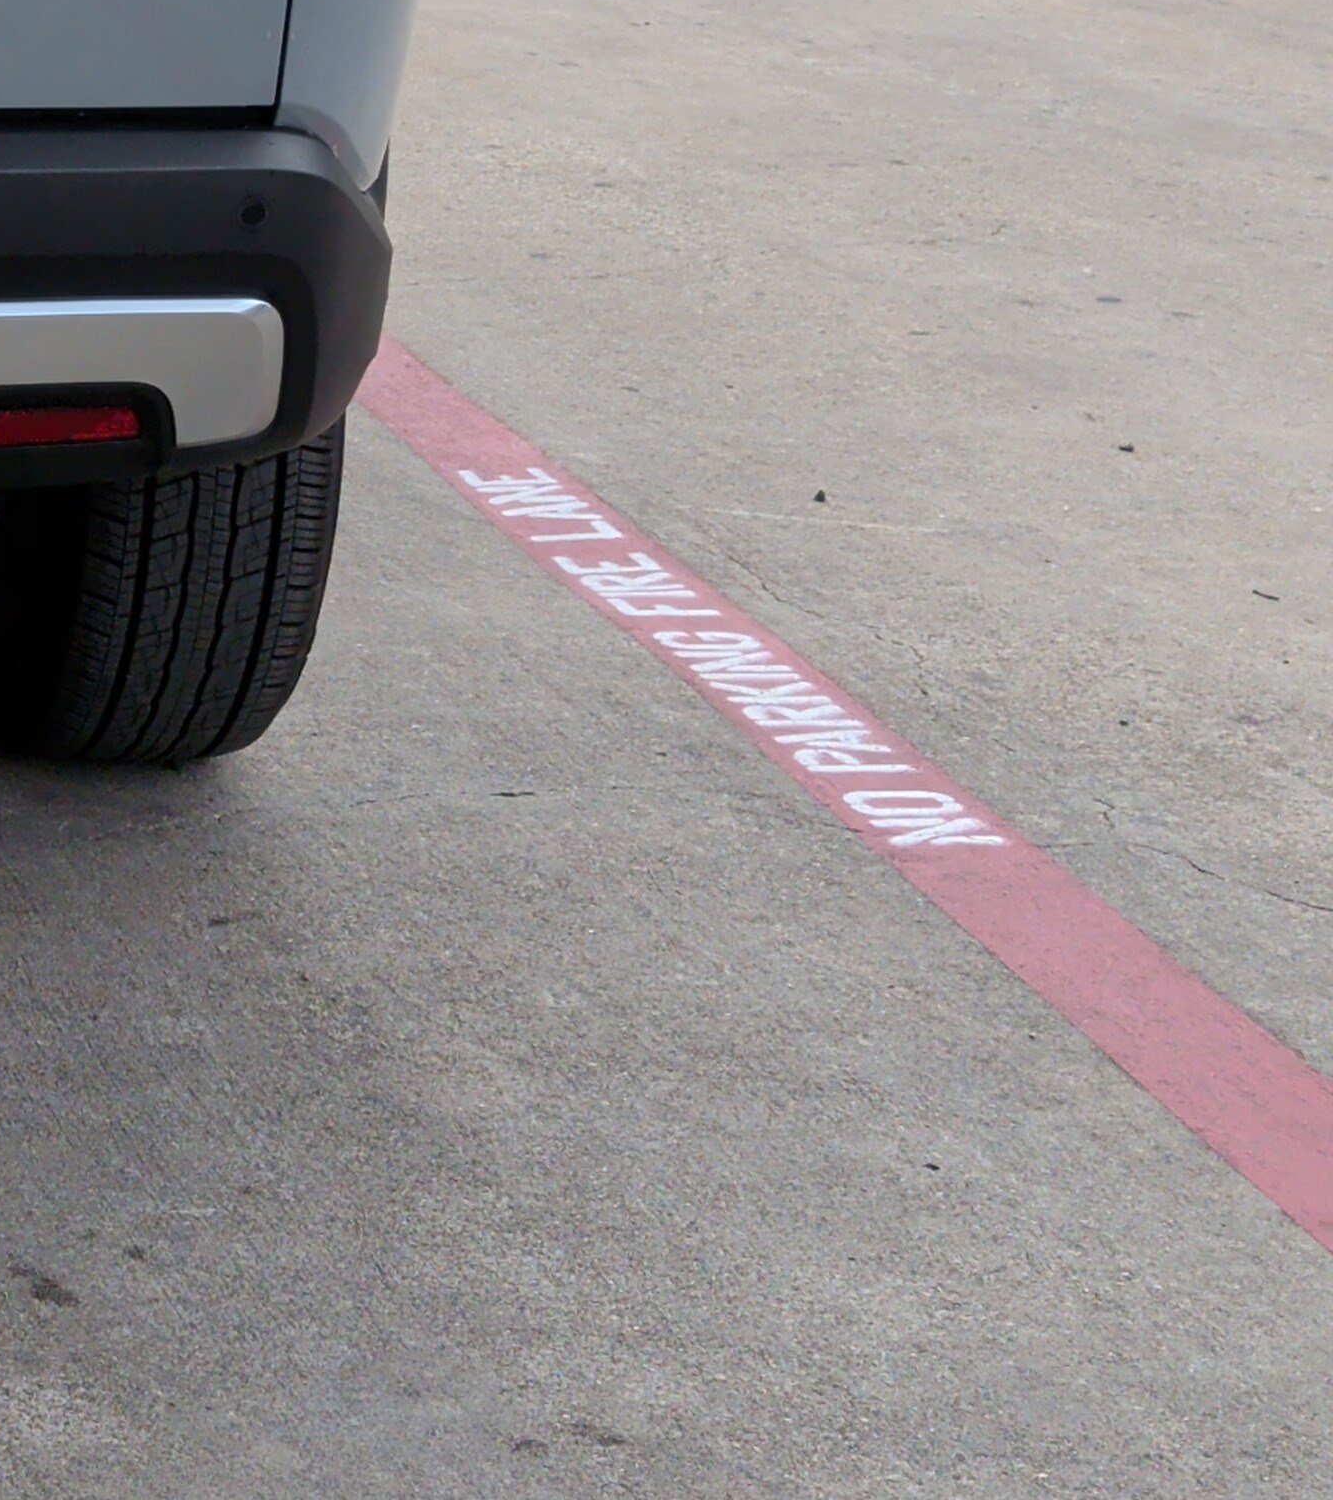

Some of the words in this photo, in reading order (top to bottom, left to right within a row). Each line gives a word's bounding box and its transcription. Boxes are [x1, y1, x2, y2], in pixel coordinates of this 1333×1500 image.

[457, 466, 624, 542] LANE
[552, 551, 722, 617] FIRE
[652, 630, 921, 775] PARKING
[842, 789, 1007, 847] NO
